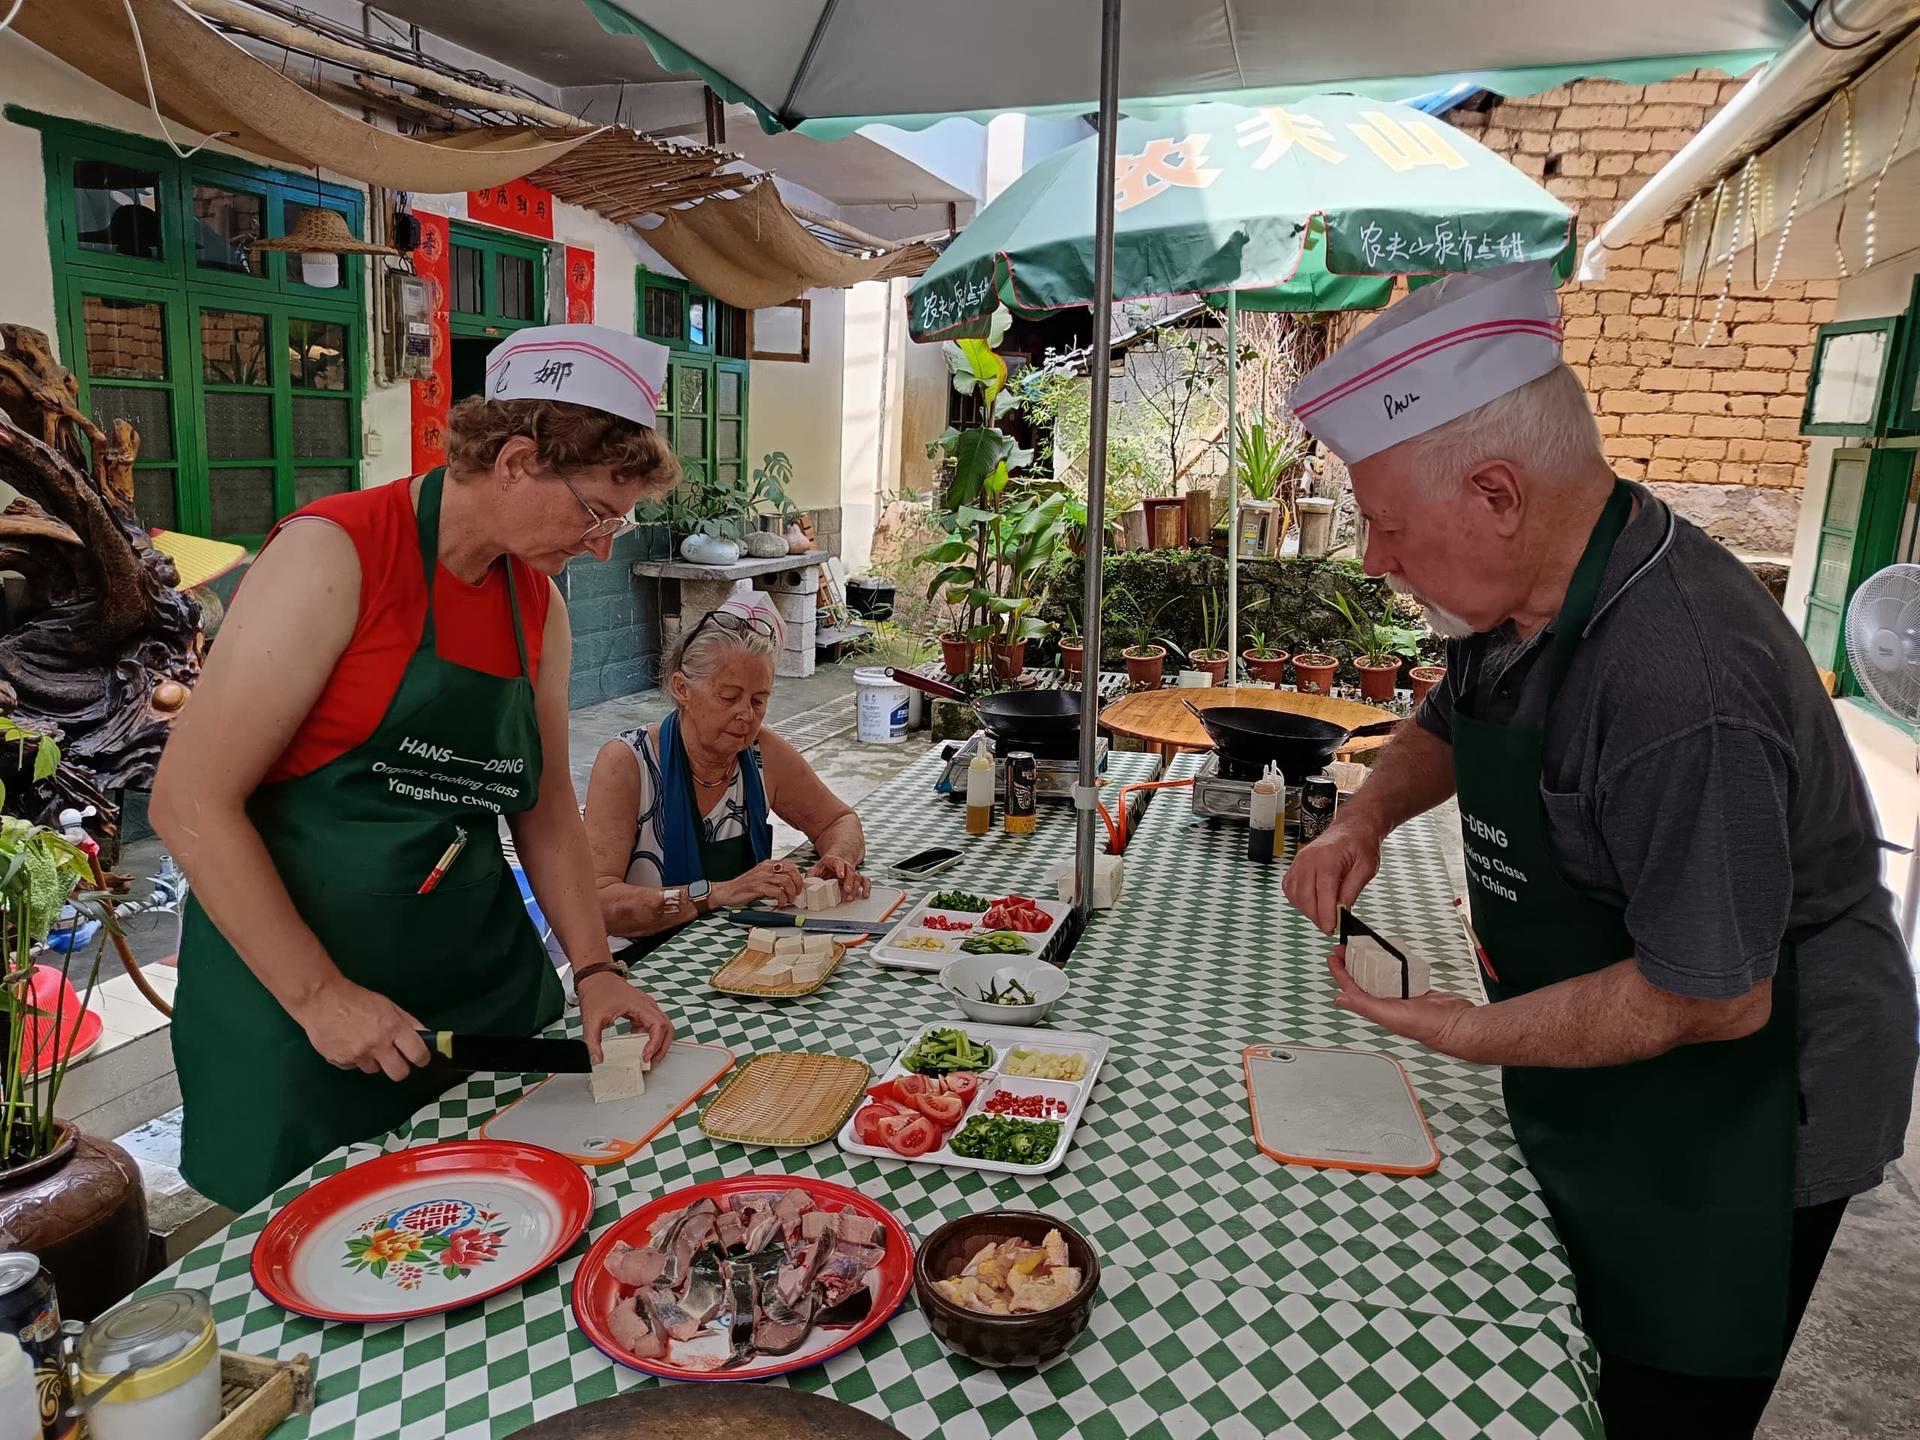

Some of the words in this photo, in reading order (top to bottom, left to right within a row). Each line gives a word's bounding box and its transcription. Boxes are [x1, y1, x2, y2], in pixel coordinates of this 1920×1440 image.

[1360, 220, 1525, 268] 农夫山泉有点甜
[1383, 393, 1420, 420] PAUL
[371, 761, 429, 777] Organic
[429, 772, 484, 791] Cooking
[485, 782, 520, 798] Class
[388, 777, 458, 804] Yangshuo
[462, 795, 501, 814] China
[1492, 858, 1528, 883] Class
[1481, 875, 1518, 902] China
